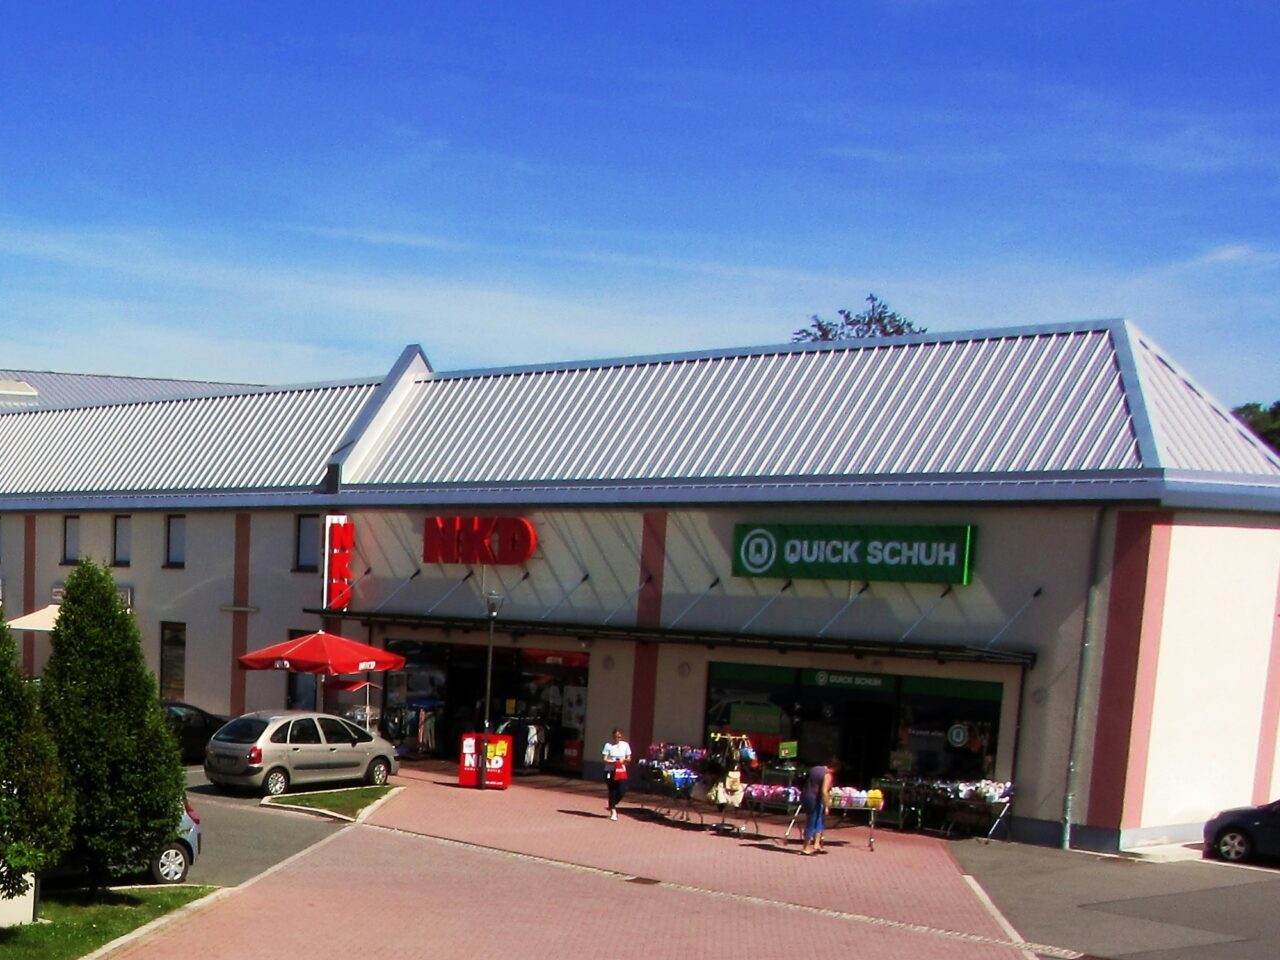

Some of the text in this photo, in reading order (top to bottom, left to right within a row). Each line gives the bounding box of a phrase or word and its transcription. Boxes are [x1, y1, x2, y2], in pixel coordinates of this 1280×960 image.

[423, 516, 538, 565] NKD
[784, 539, 957, 566] QUICK SCHUH
[329, 522, 354, 609] NKD
